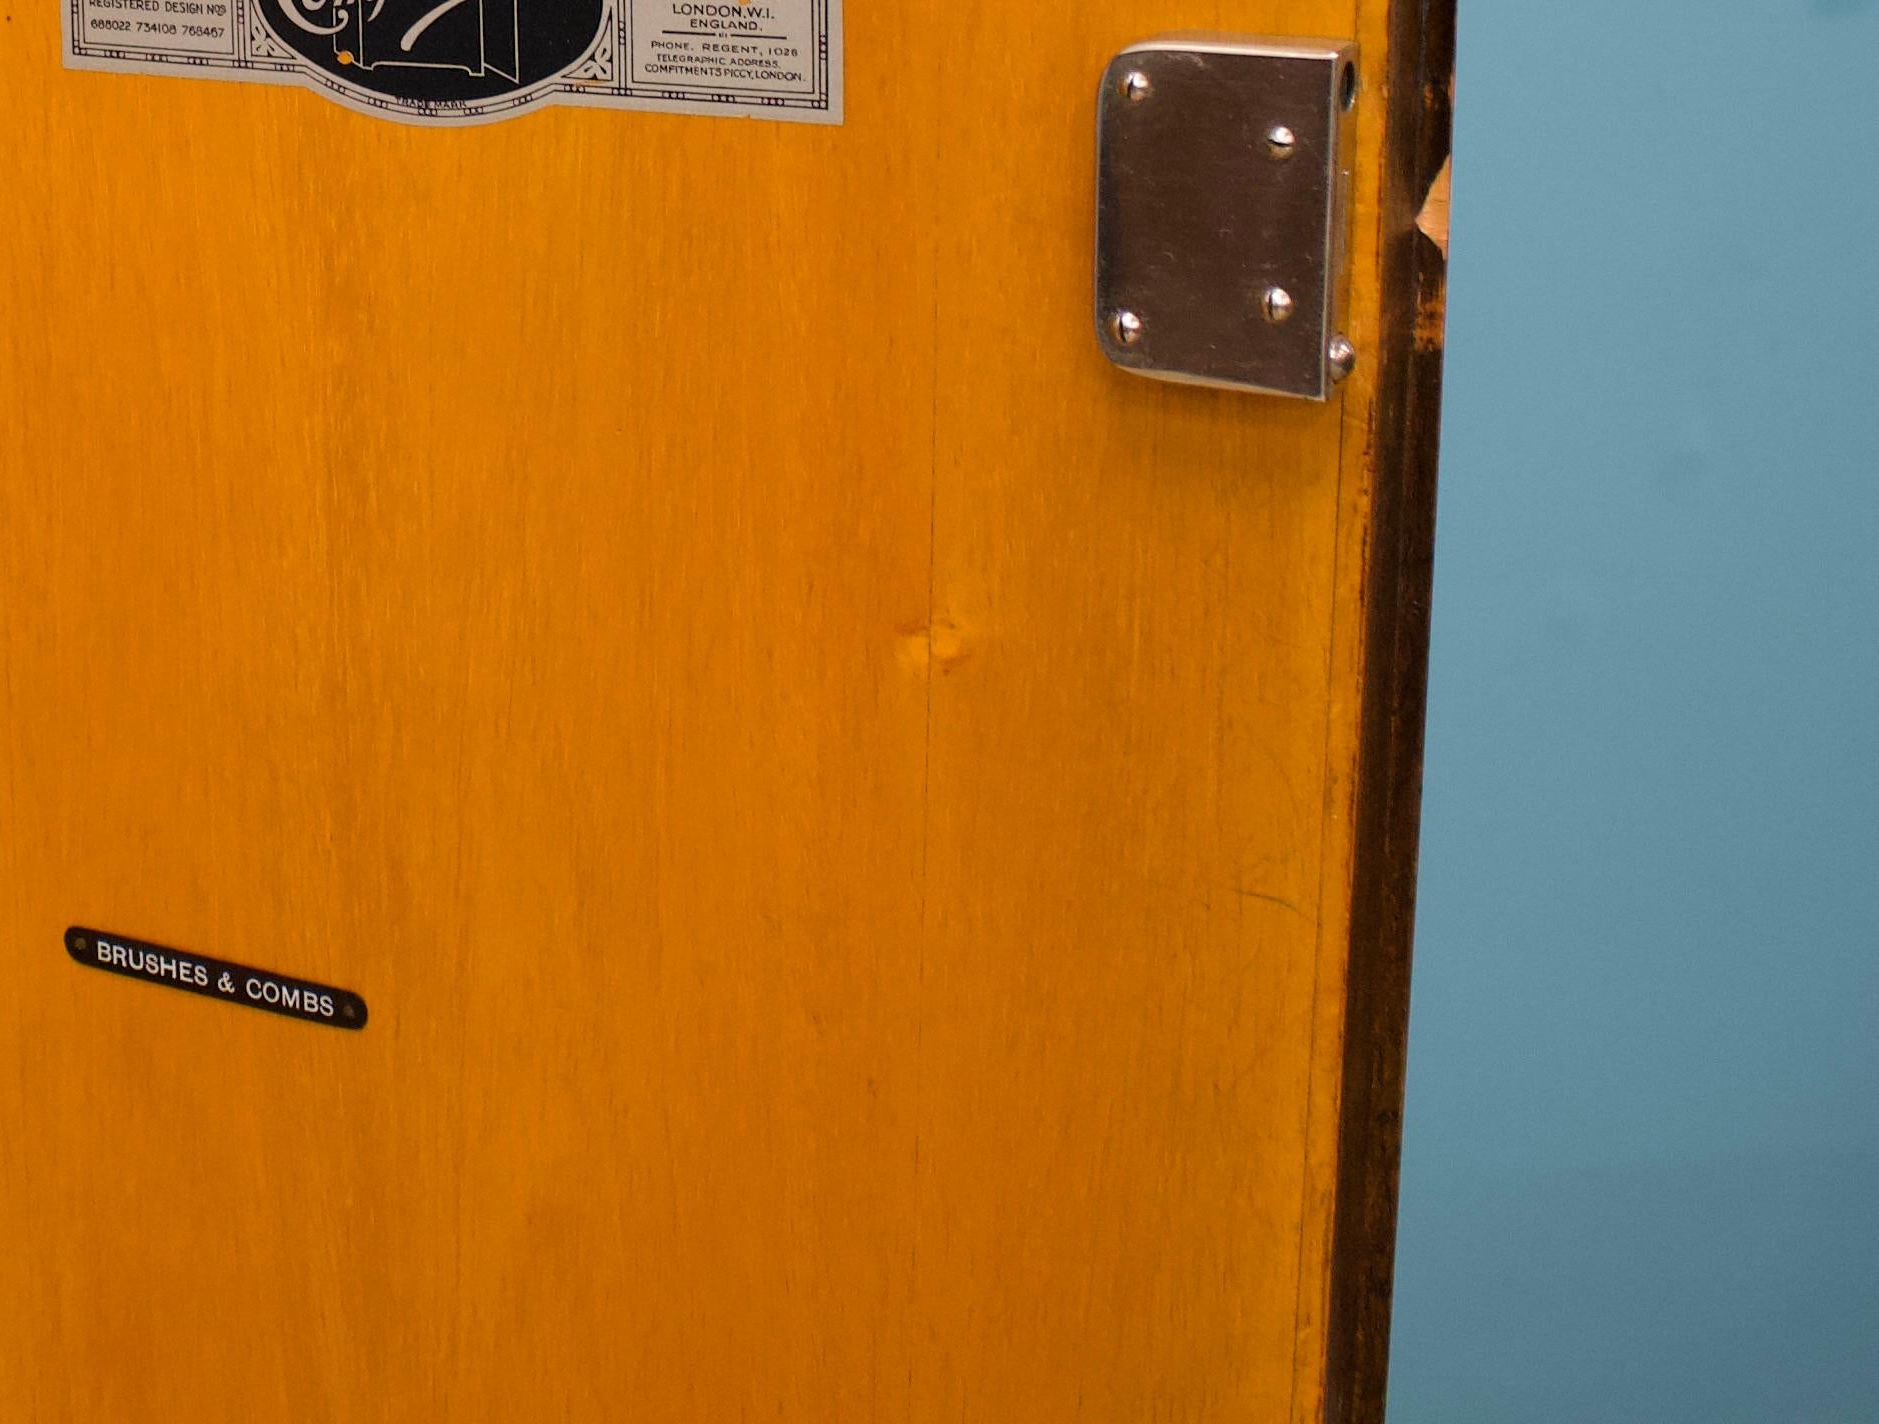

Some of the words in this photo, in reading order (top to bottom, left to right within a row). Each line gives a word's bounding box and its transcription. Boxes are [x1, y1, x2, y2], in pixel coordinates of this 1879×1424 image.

[165, 2, 203, 15] DESIGN
[657, 54, 727, 65] TELEGRAPHIC
[96, 940, 209, 986] BRUSHES
[217, 971, 236, 994] &
[245, 978, 335, 1017] COMBS
